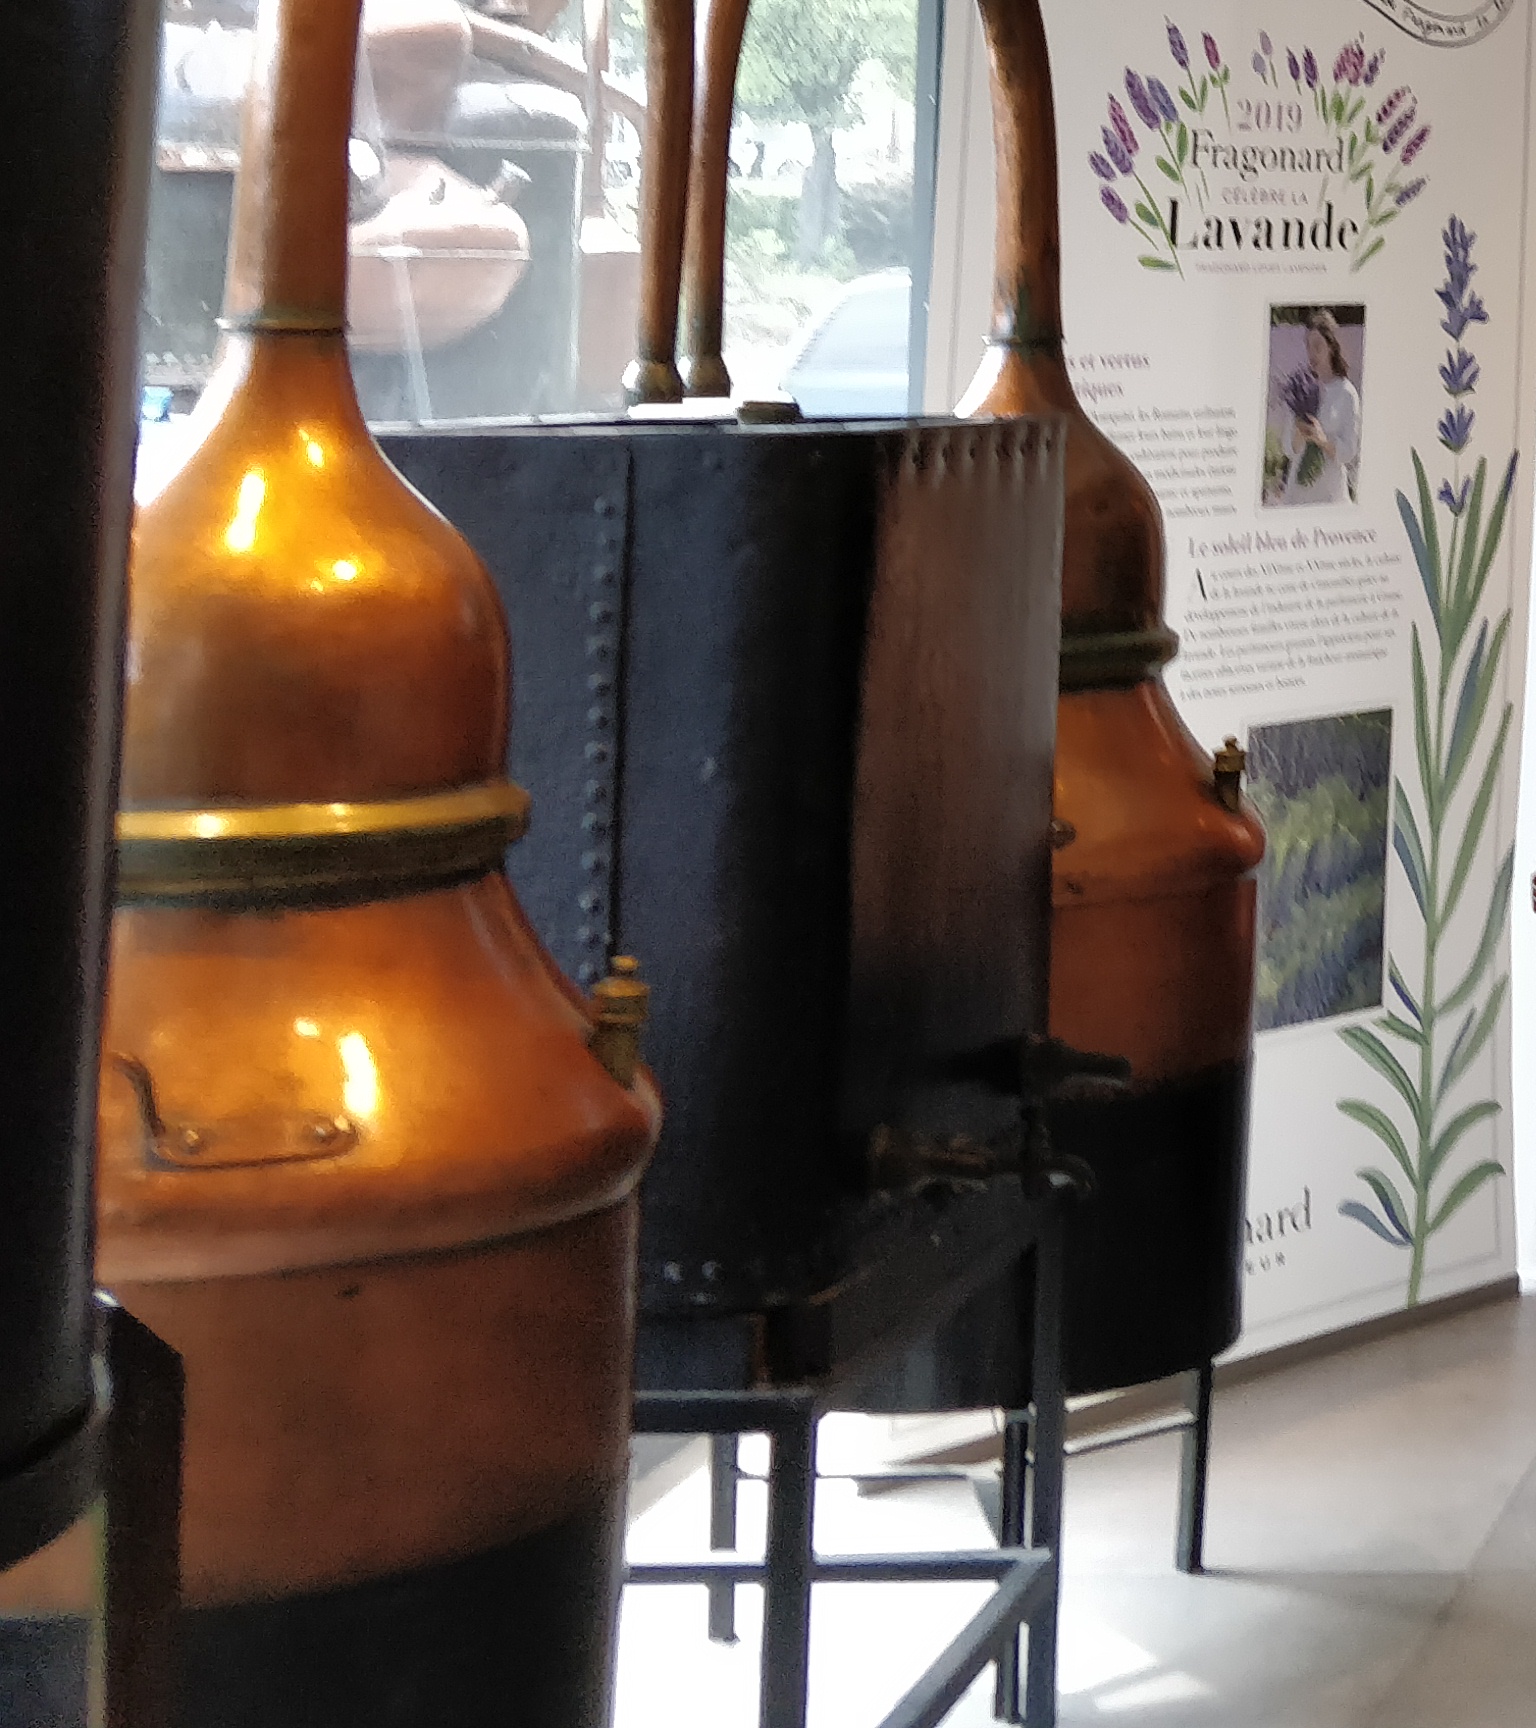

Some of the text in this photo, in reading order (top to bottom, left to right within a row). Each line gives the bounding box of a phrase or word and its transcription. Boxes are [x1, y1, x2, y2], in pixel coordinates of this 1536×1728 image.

[1236, 97, 1303, 133] 2019
[1191, 127, 1345, 182] Fragonard
[1168, 196, 1360, 251] Lavande
